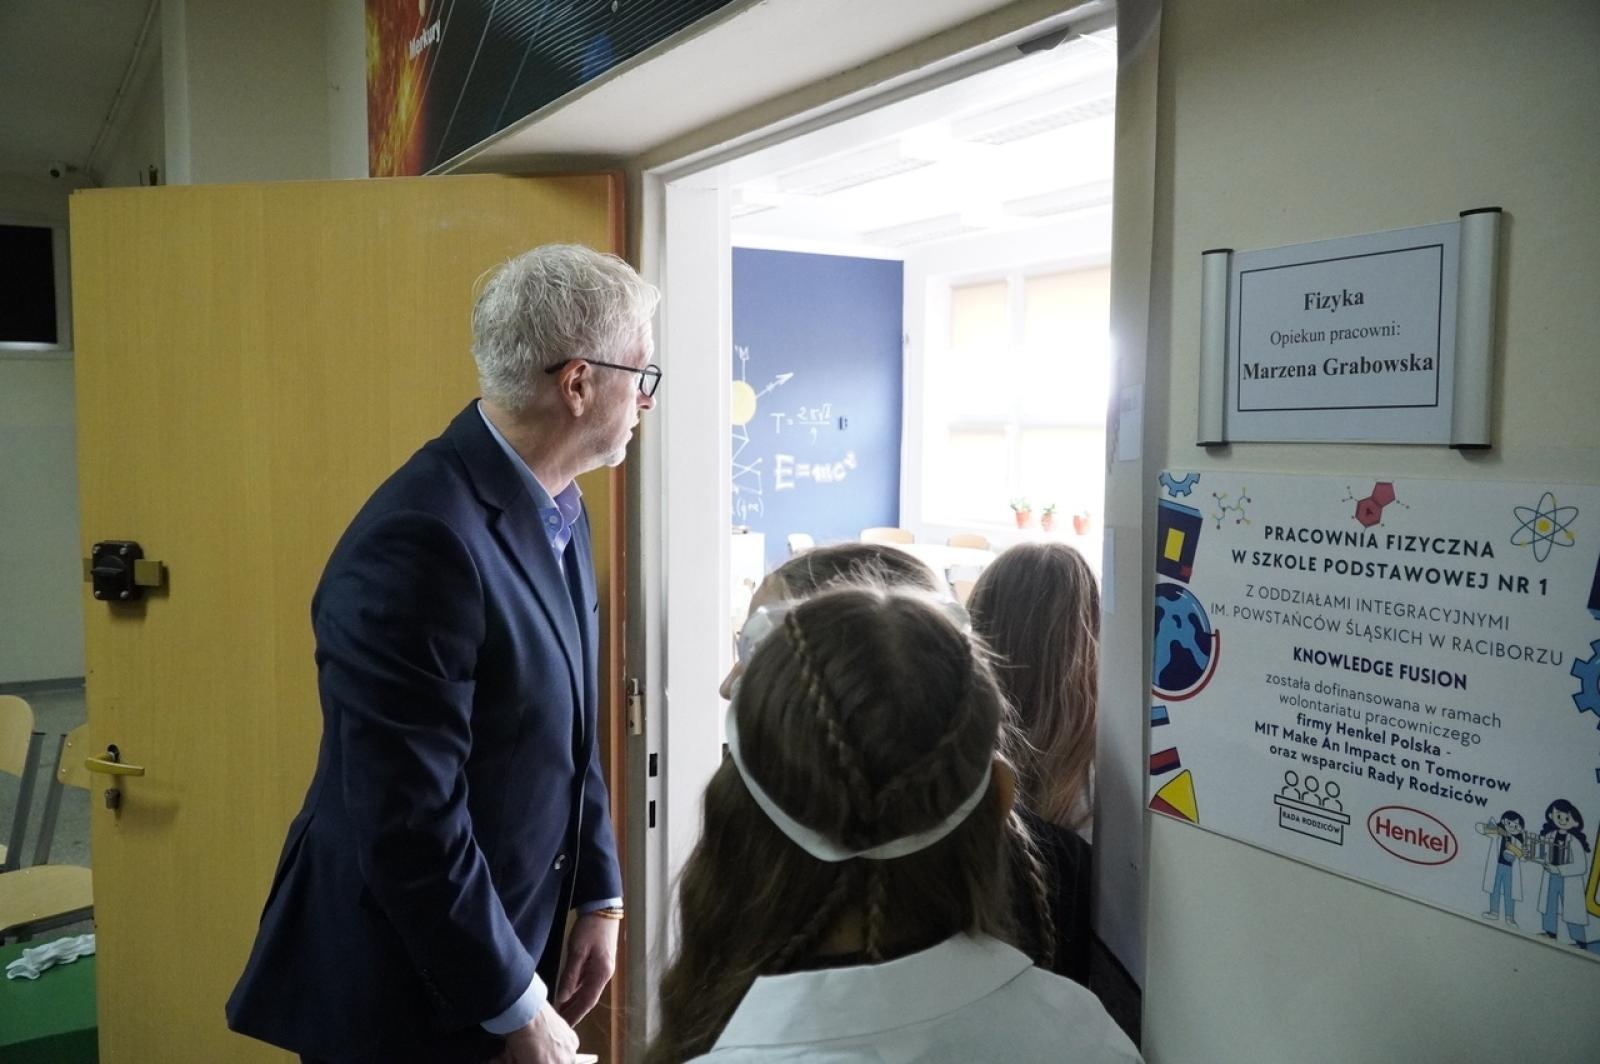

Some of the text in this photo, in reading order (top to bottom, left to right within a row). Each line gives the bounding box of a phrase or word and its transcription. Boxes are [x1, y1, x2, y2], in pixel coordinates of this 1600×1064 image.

[409, 20, 440, 60] Merkury
[1303, 289, 1364, 312] Fizyka
[1270, 320, 1400, 348] Opiekun pracowni:
[1242, 353, 1433, 380] Marzena Grabowska
[1264, 526, 1495, 558] PRACOWNIA FIZYCZNA
[1232, 549, 1548, 596] W SZKOLE PODSTAWOWEJ NR 1
[1246, 584, 1510, 630] Z ODDZIAŁAMI INTEGRACYJNYMI
[1210, 602, 1563, 666] IM. POWSTAŃCÓW ŚLĄSKICH W RACIBORZU
[1293, 646, 1467, 690] KNOWLEDGE FUSION
[1266, 674, 1502, 728] została dofinansowana w ramach
[1280, 694, 1481, 747] wolontariatu pracowniczego
[1254, 720, 1511, 792] MIT Make An Impact on Tomorrow
[1296, 712, 1332, 736] firmy
[1336, 721, 1386, 744] Henkel
[1391, 733, 1440, 756] Polska
[1269, 745, 1488, 808] oraz wsparciu Rady Rodziców
[1282, 812, 1340, 833] RADA RODZICÓW
[1375, 817, 1450, 854] Henkel
